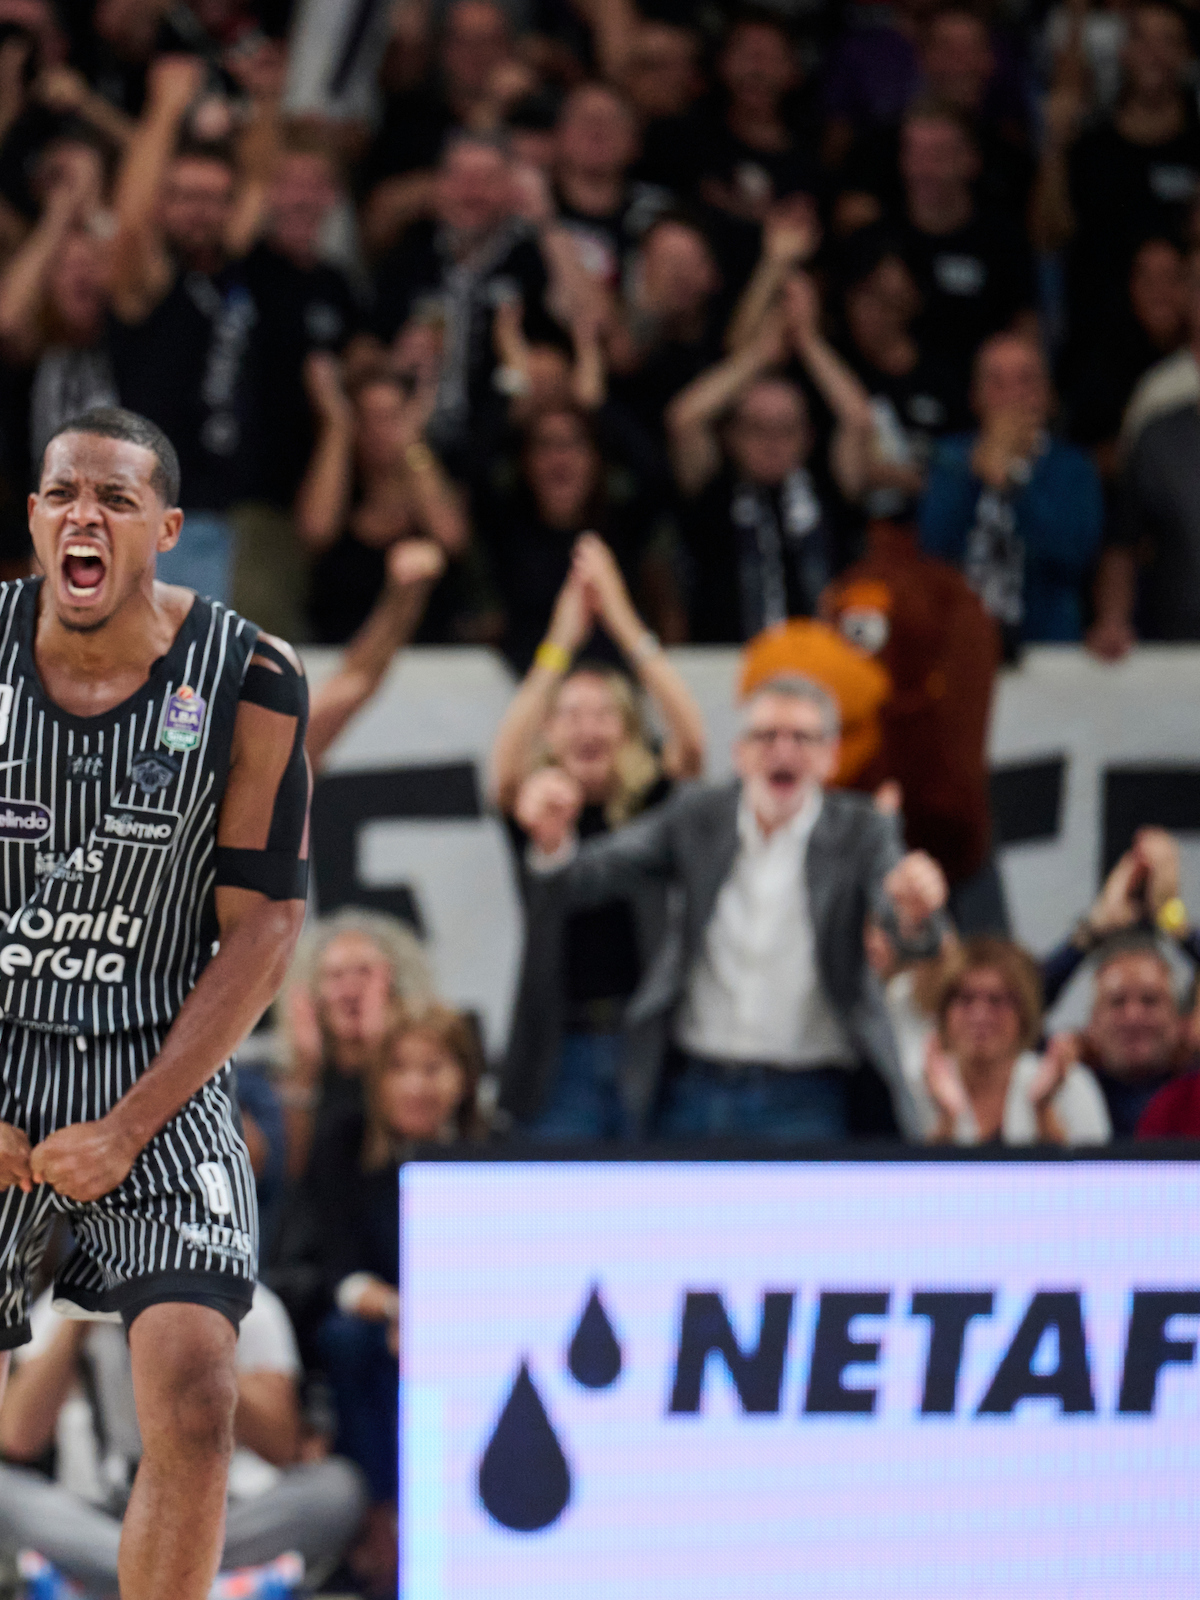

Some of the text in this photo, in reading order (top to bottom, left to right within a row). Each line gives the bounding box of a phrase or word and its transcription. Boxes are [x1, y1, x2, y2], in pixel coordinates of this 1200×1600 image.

[169, 710, 199, 726] LBA
[197, 1162, 231, 1215] 8
[669, 1290, 1200, 1414] NETAF
